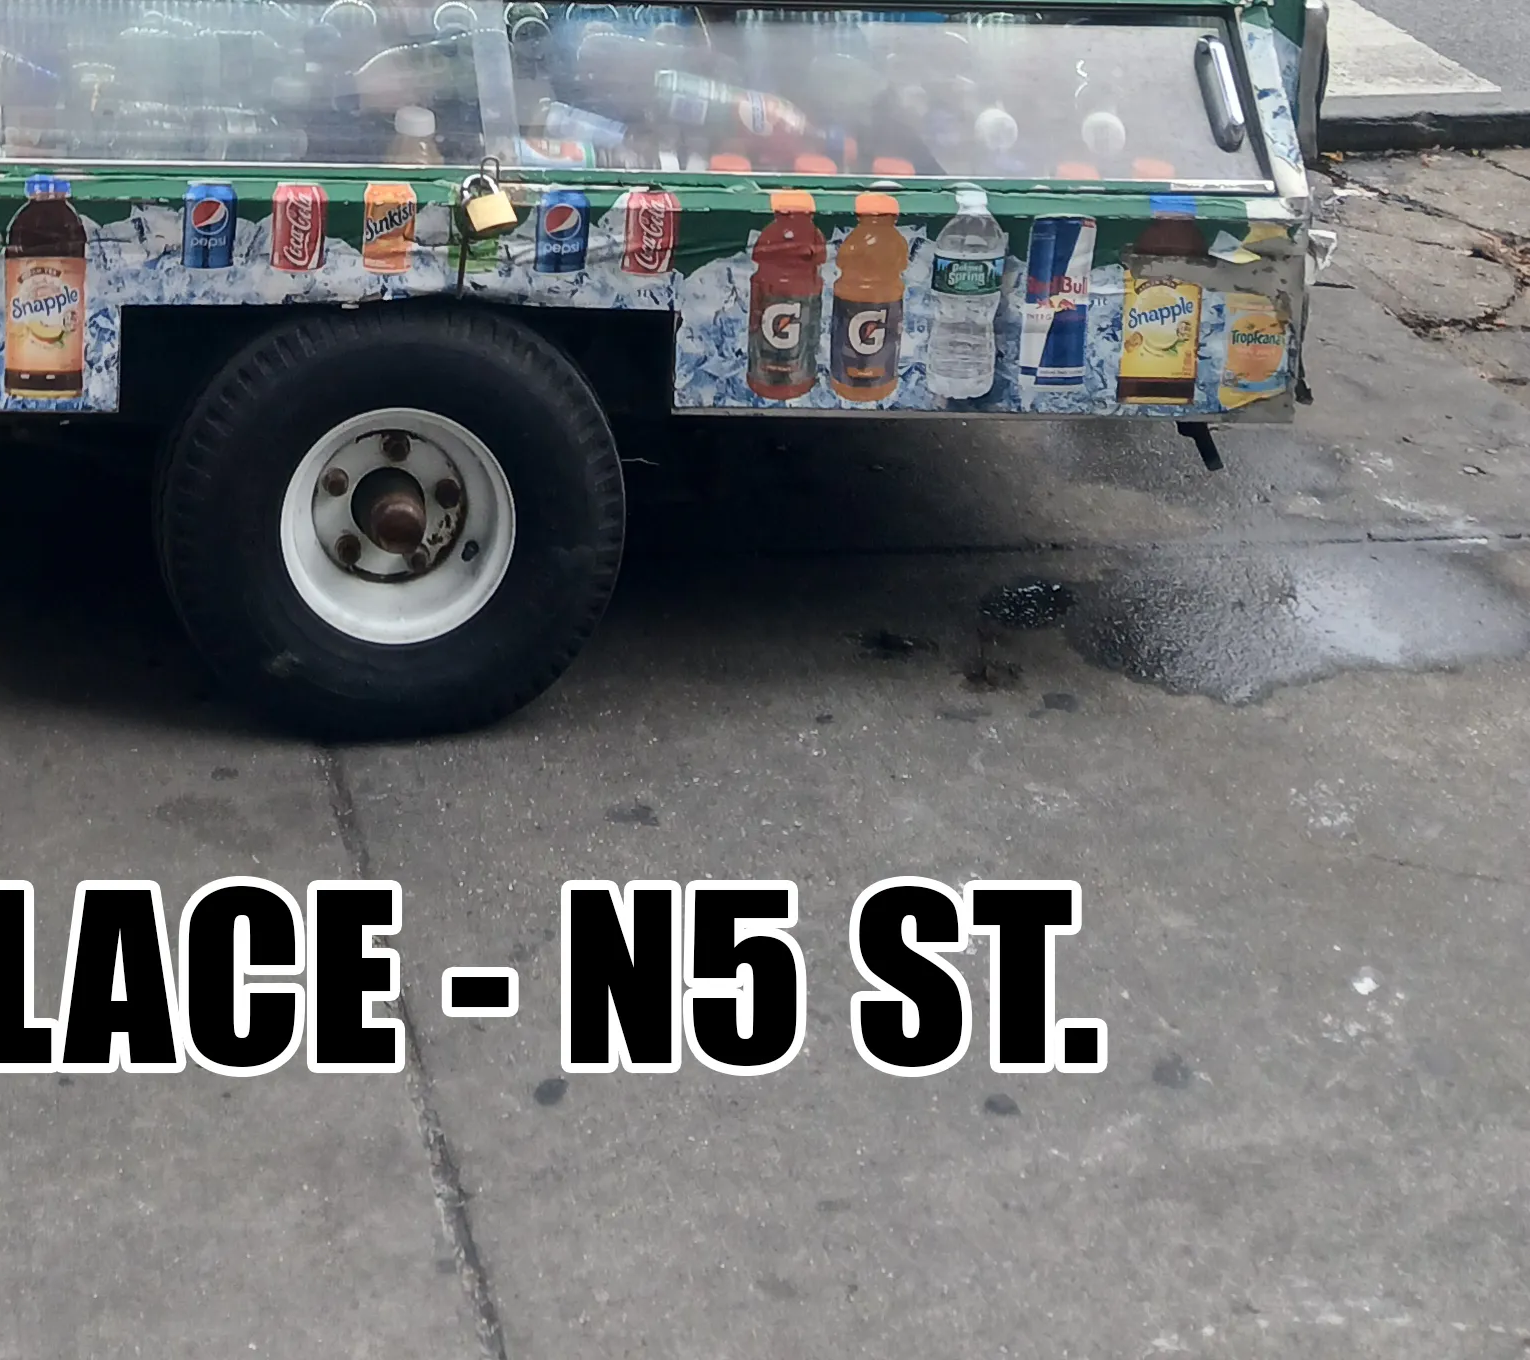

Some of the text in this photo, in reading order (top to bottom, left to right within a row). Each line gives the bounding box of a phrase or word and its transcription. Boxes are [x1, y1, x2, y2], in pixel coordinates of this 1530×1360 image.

[365, 200, 416, 240] Sunkist
[190, 235, 227, 249] pepsi
[543, 241, 581, 256] pepsi
[948, 272, 985, 286] Spring
[1062, 277, 1087, 293] Bull
[12, 286, 78, 319] Snapple
[1128, 297, 1193, 328] Snapple
[761, 303, 801, 350] G
[847, 310, 887, 356] G
